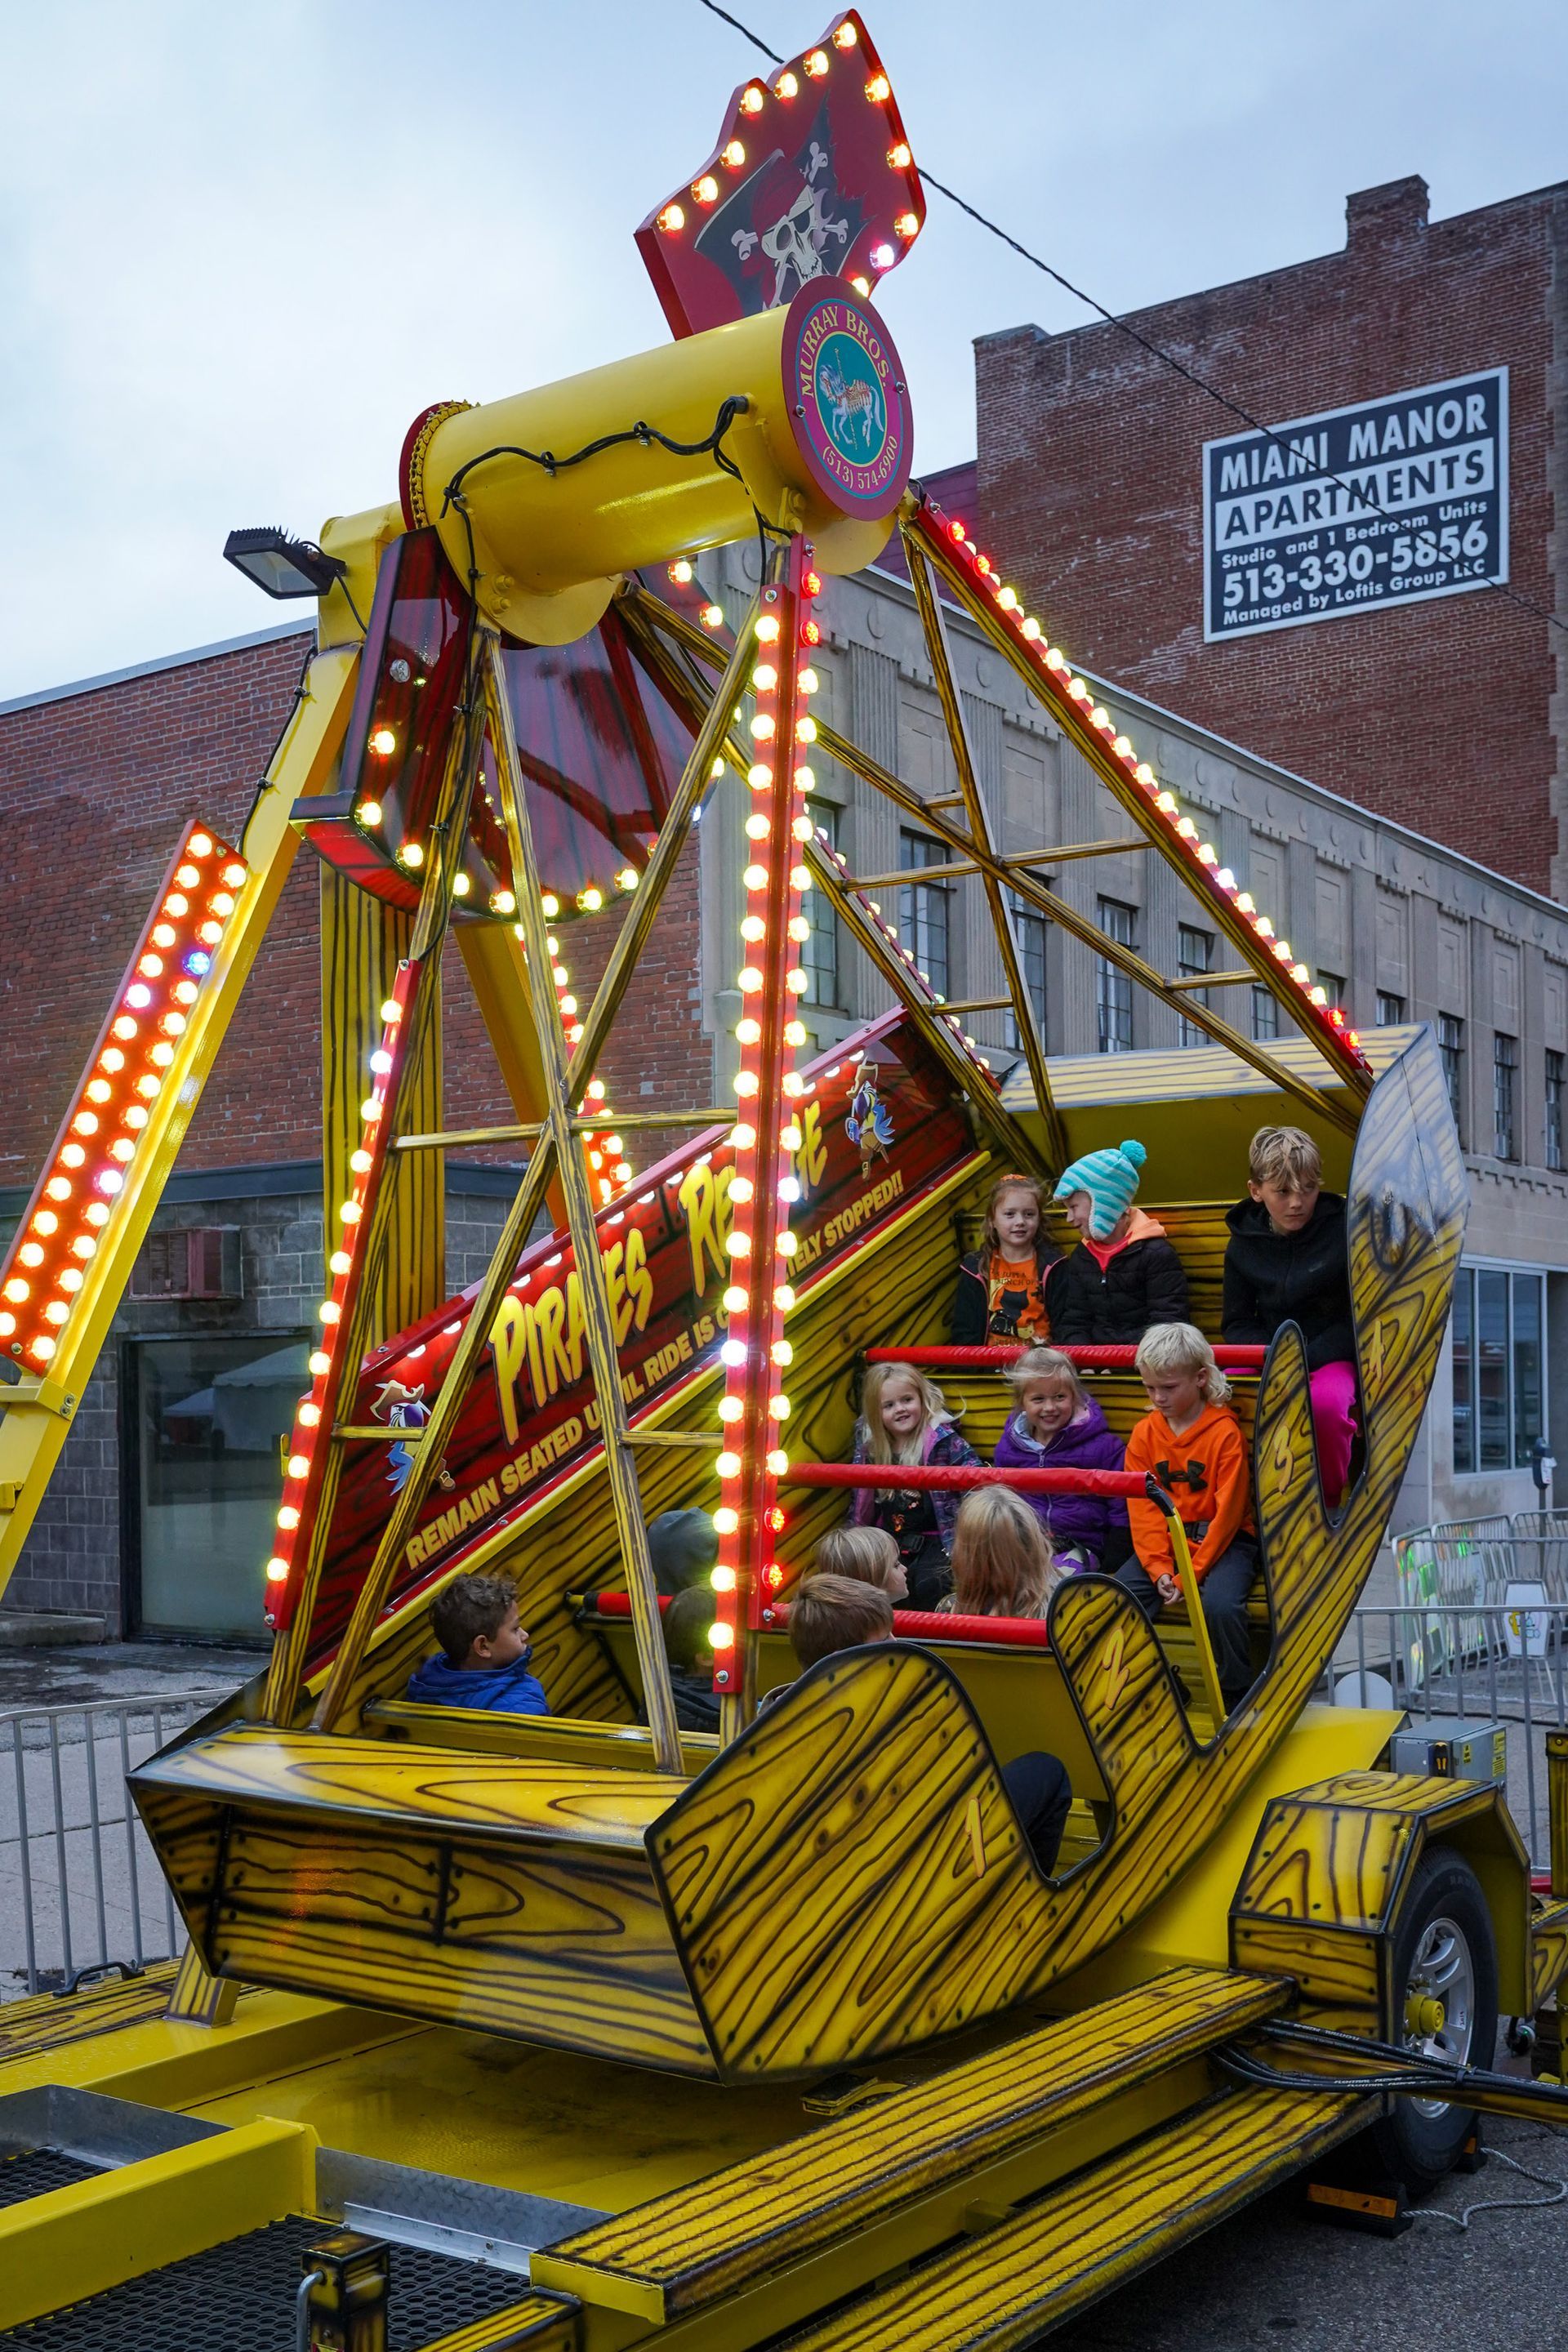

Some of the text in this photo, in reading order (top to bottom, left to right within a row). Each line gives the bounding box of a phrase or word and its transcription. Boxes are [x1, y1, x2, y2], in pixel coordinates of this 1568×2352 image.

[801, 305, 889, 399] MURRAY BROS.
[822, 435, 898, 490] (513) 574-6900
[1220, 393, 1488, 492] MIAMI MANOR
[1222, 500, 1488, 569] Studio and 1 Bedroom Units
[1224, 449, 1485, 541] APARTMENTS
[1223, 519, 1488, 608] 513-330-5856
[1223, 559, 1486, 625] Managed by Loftis Group LLC
[405, 1478, 501, 1570] REMAIN
[501, 1416, 583, 1495] SEATED
[643, 1331, 693, 1388] RIDE
[693, 1316, 715, 1348] IS
[823, 1169, 904, 1248] STOPPED!!
[1273, 1425, 1294, 1495] 3
[1102, 1627, 1130, 1710] 2
[964, 1797, 987, 1879] 1
